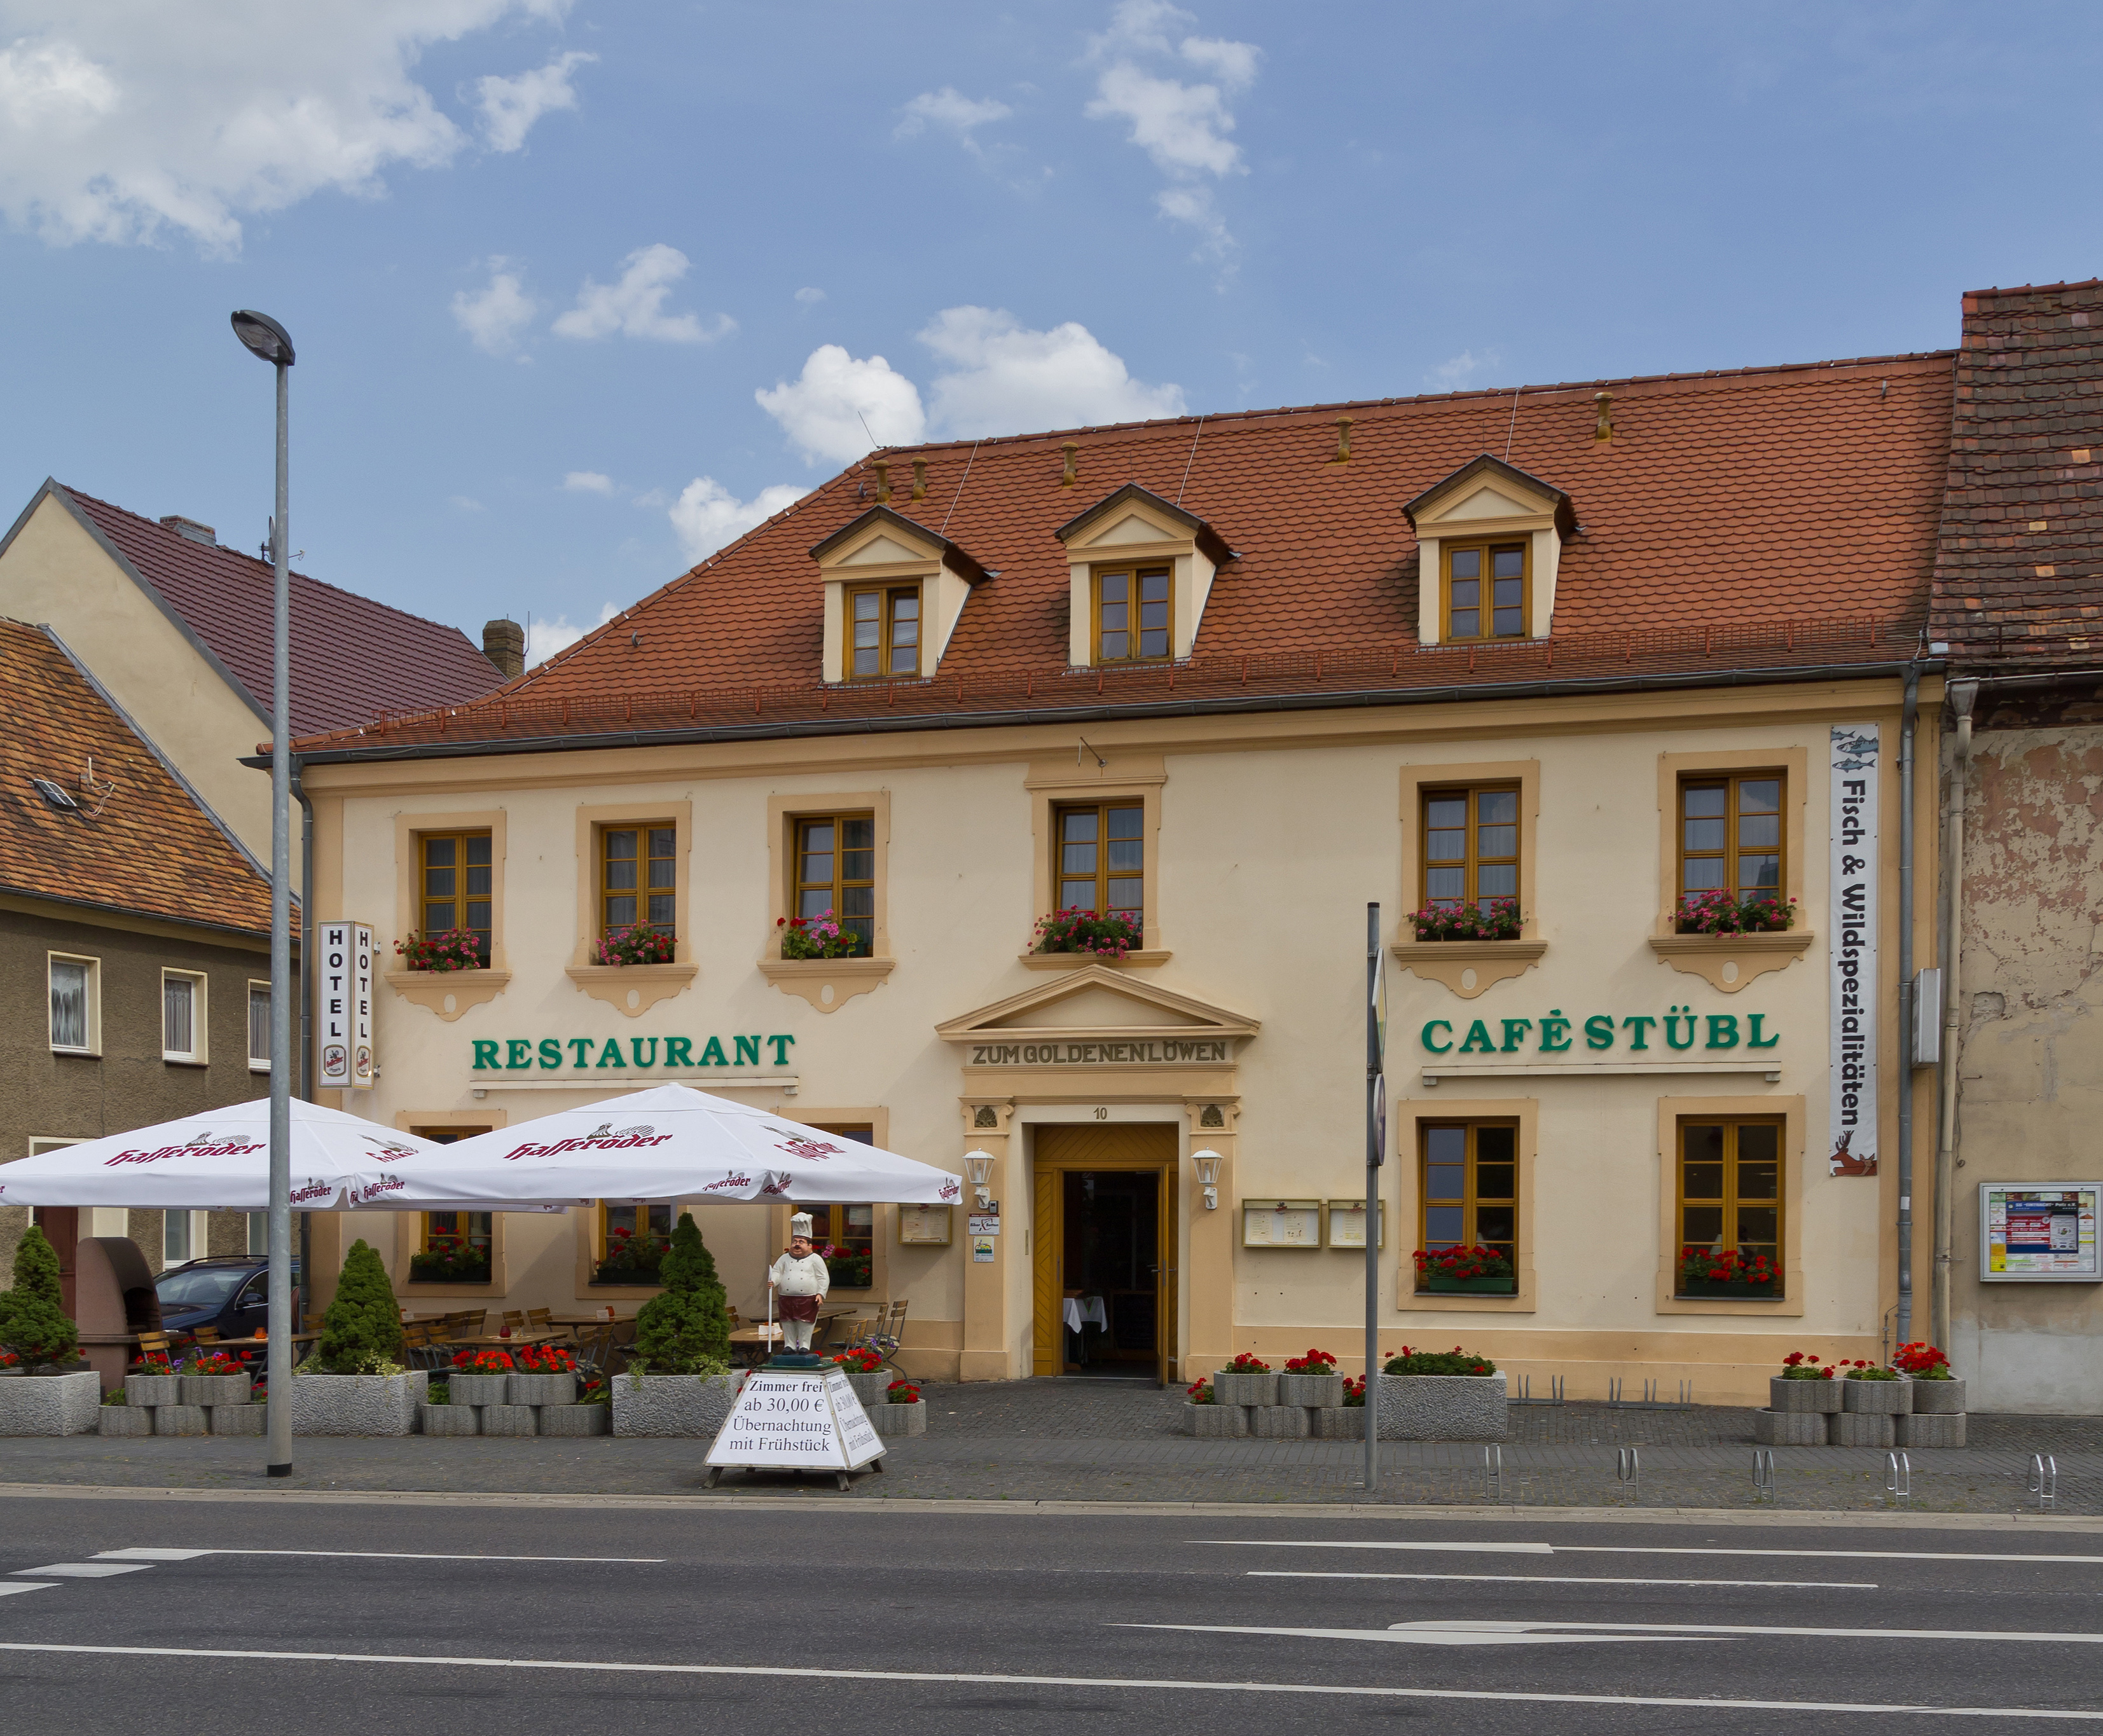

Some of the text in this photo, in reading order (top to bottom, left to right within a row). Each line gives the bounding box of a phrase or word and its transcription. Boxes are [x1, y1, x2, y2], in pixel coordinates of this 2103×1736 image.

[1837, 780, 1865, 1126] Fisch & Wildspezialitäten
[329, 930, 343, 1037] HOTEL
[359, 931, 368, 1038] HOTEL
[472, 1035, 796, 1070] RESTAURANT
[973, 1040, 1225, 1064] ZUM GOLDENEN LÖWEN
[1093, 1107, 1108, 1120] 10
[749, 1381, 822, 1393] Zimmer frei
[744, 1398, 824, 1414] ab 30,00 €
[733, 1416, 832, 1435] Übernachtung
[729, 1437, 831, 1452] mit Frühstück
